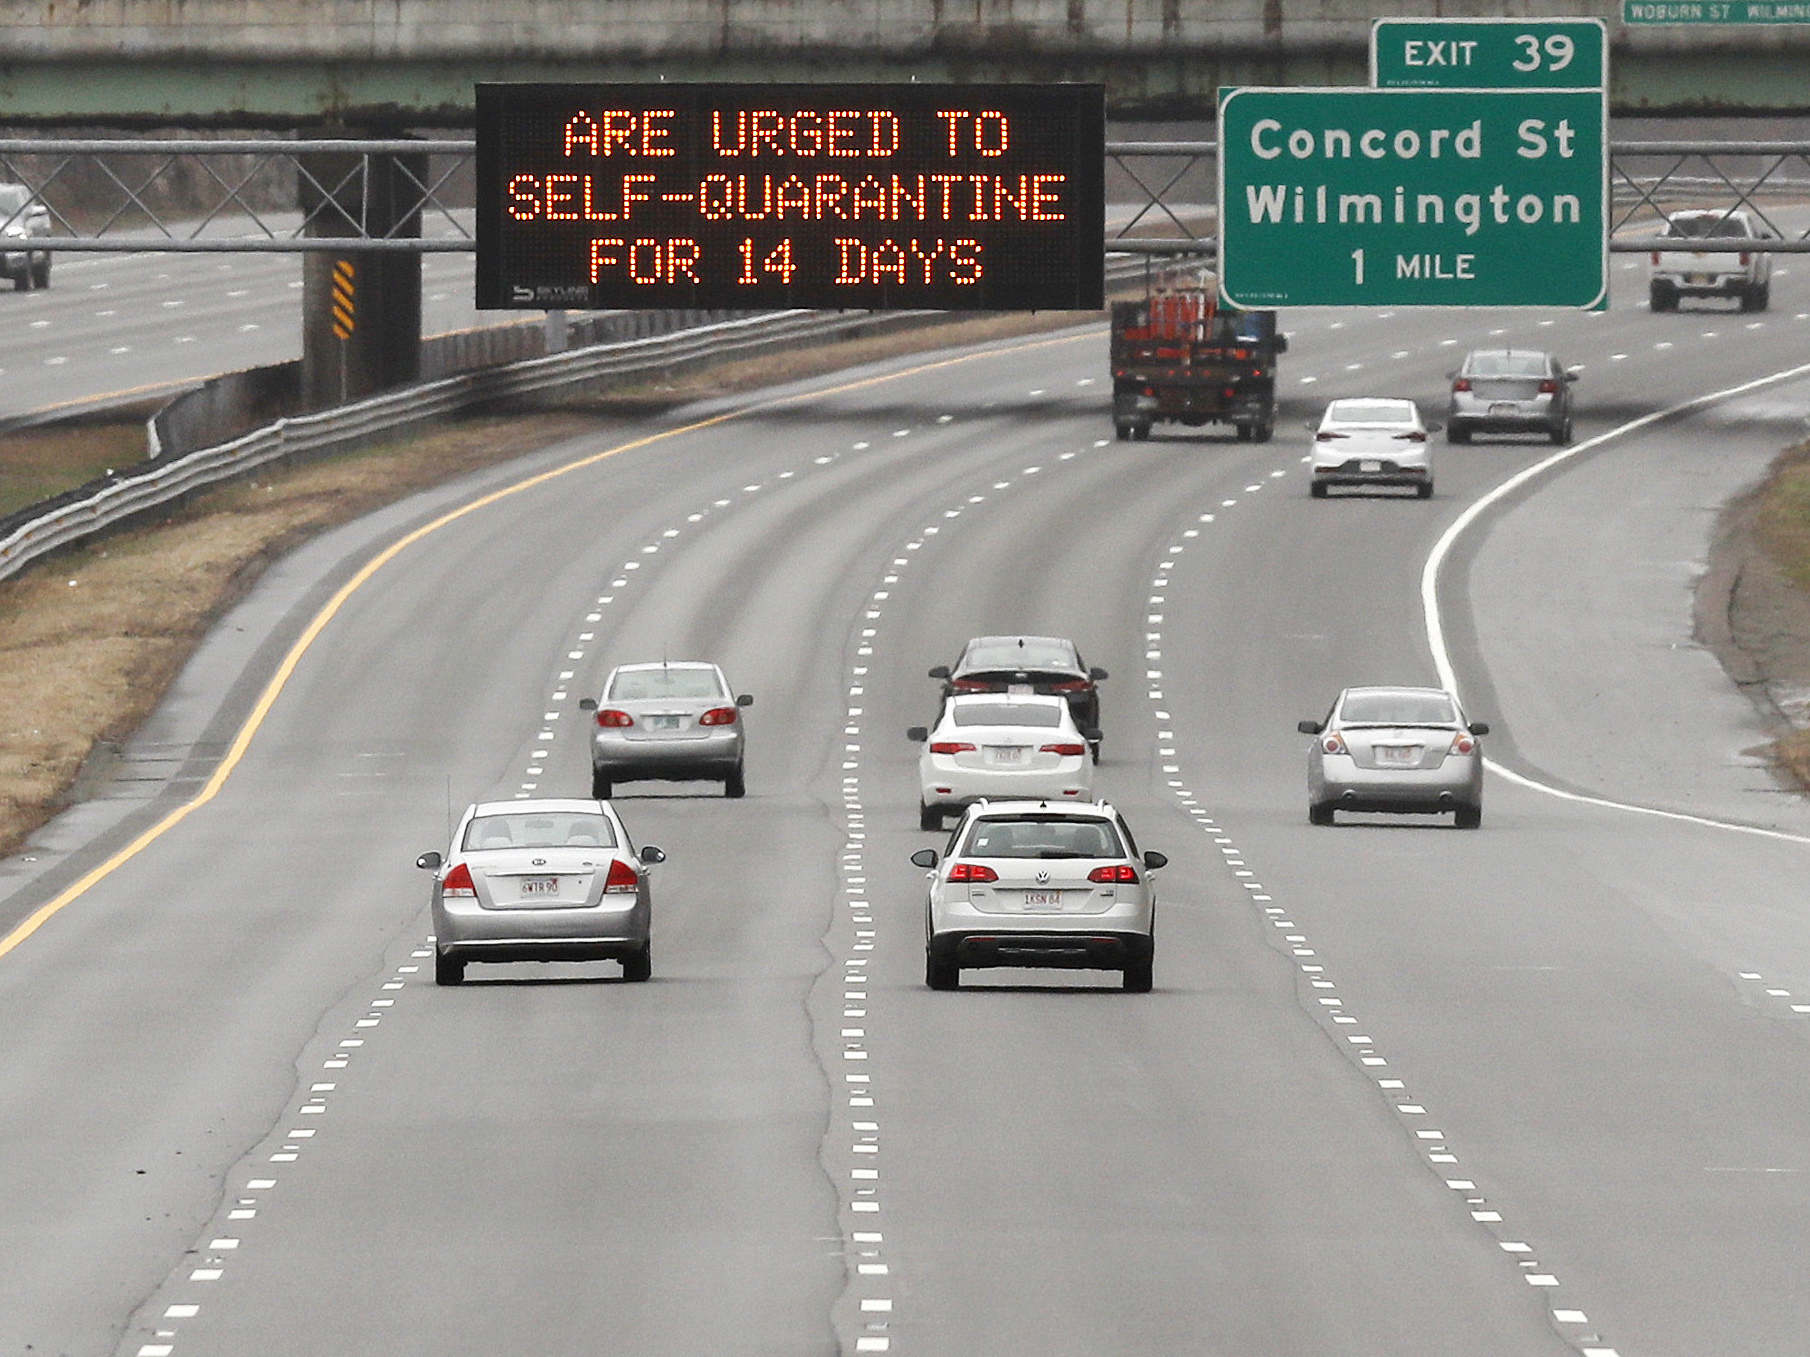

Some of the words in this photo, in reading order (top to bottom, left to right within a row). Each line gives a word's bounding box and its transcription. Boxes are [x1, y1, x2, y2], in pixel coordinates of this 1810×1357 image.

[1631, 4, 1702, 19] WOBURN
[1709, 4, 1731, 19] ST
[1404, 40, 1478, 66] EXIT
[1512, 34, 1575, 72] 39
[564, 110, 676, 157] ARE
[712, 110, 899, 157] URGED
[936, 110, 1009, 157] TO
[1250, 119, 1481, 160] Concord
[1517, 119, 1575, 159] St
[508, 173, 1066, 221] SELF-QUARANTINE
[1246, 184, 1580, 236] Wilmington
[590, 238, 701, 285] FOR
[737, 237, 797, 285] 14
[834, 237, 983, 285] DAYS
[1351, 248, 1364, 285] 1
[1396, 254, 1475, 280] MILE
